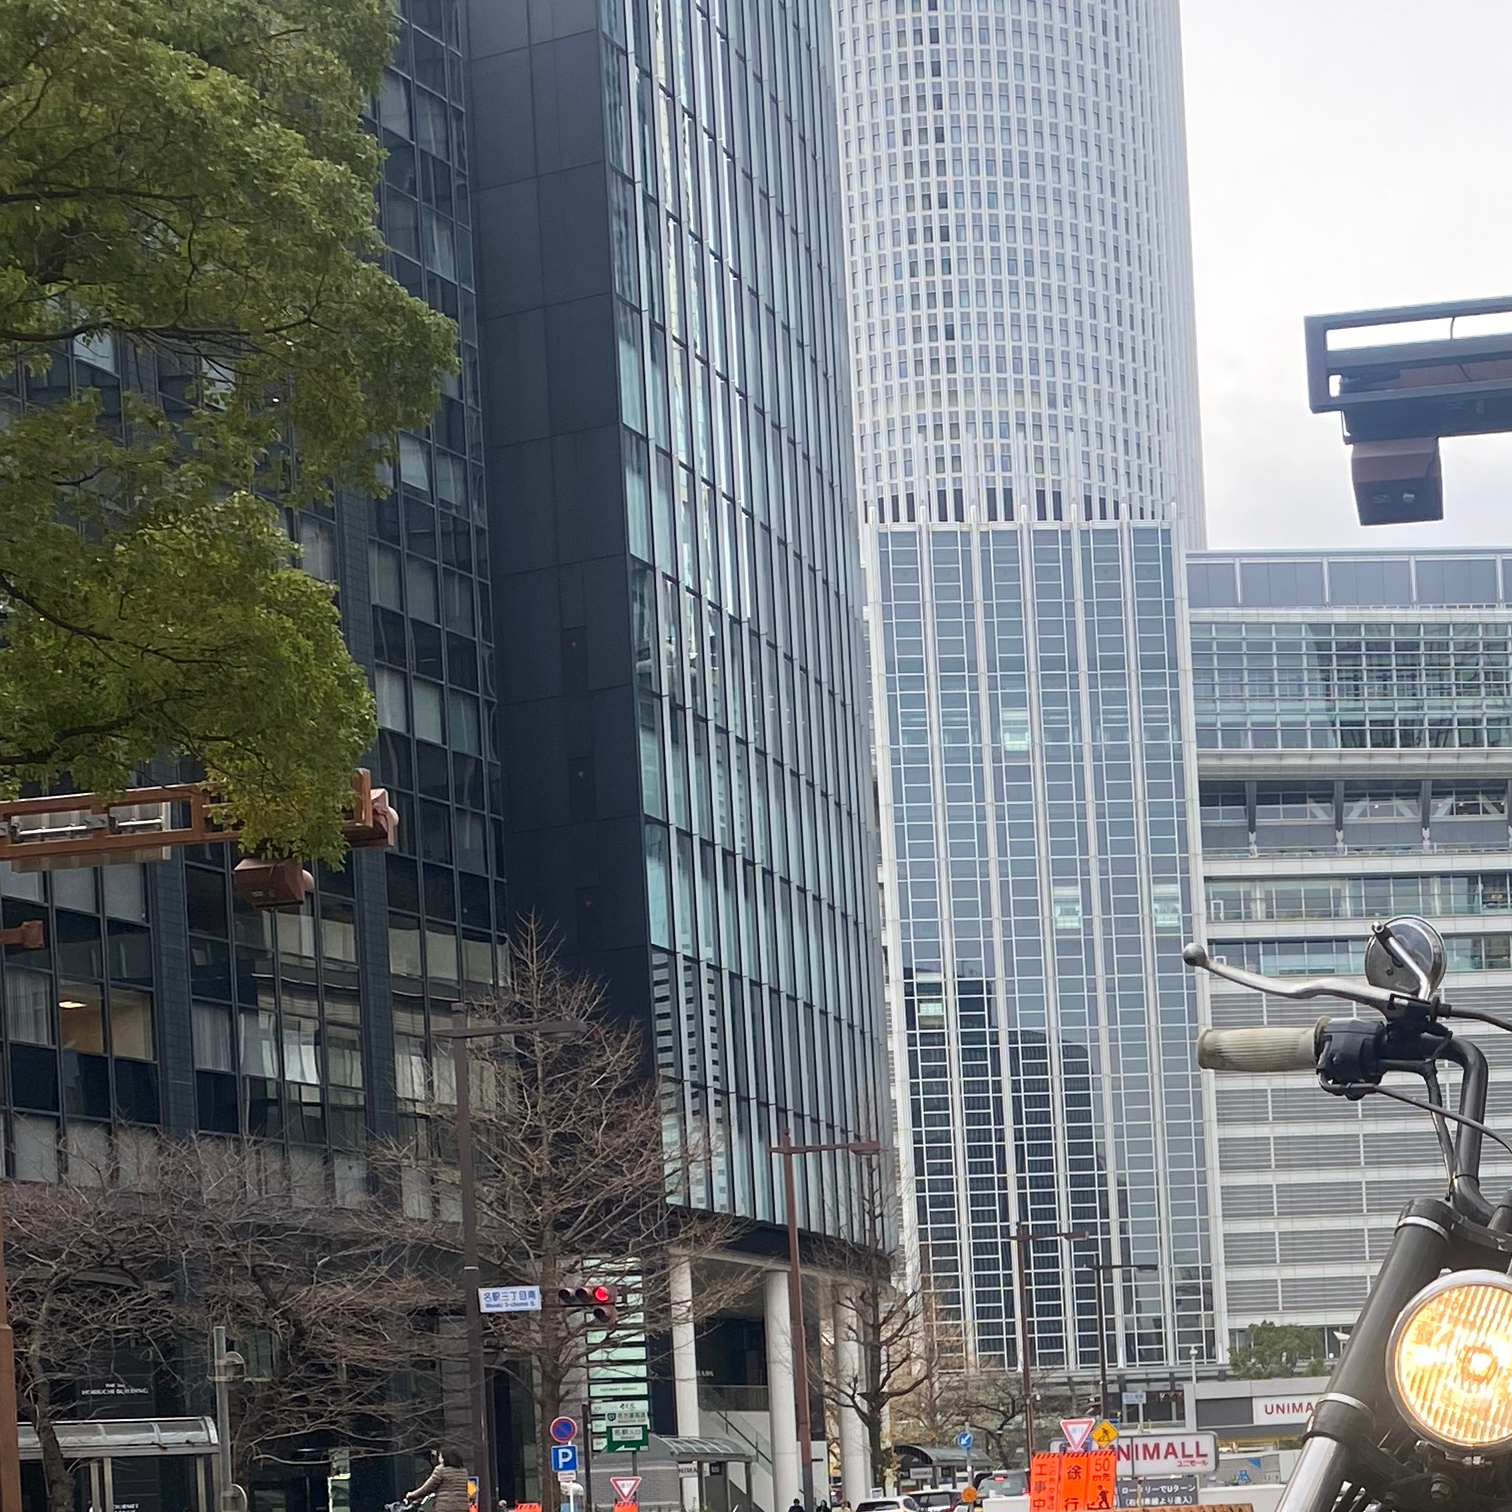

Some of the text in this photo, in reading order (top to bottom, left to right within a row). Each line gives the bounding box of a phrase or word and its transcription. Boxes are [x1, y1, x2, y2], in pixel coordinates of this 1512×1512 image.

[1264, 1402, 1314, 1415] UNIMA
[1112, 1441, 1208, 1461] NIMALL
[558, 1448, 573, 1469] P
[1095, 1458, 1110, 1472] 50
[1122, 1485, 1196, 1495] ローリーでUターン
